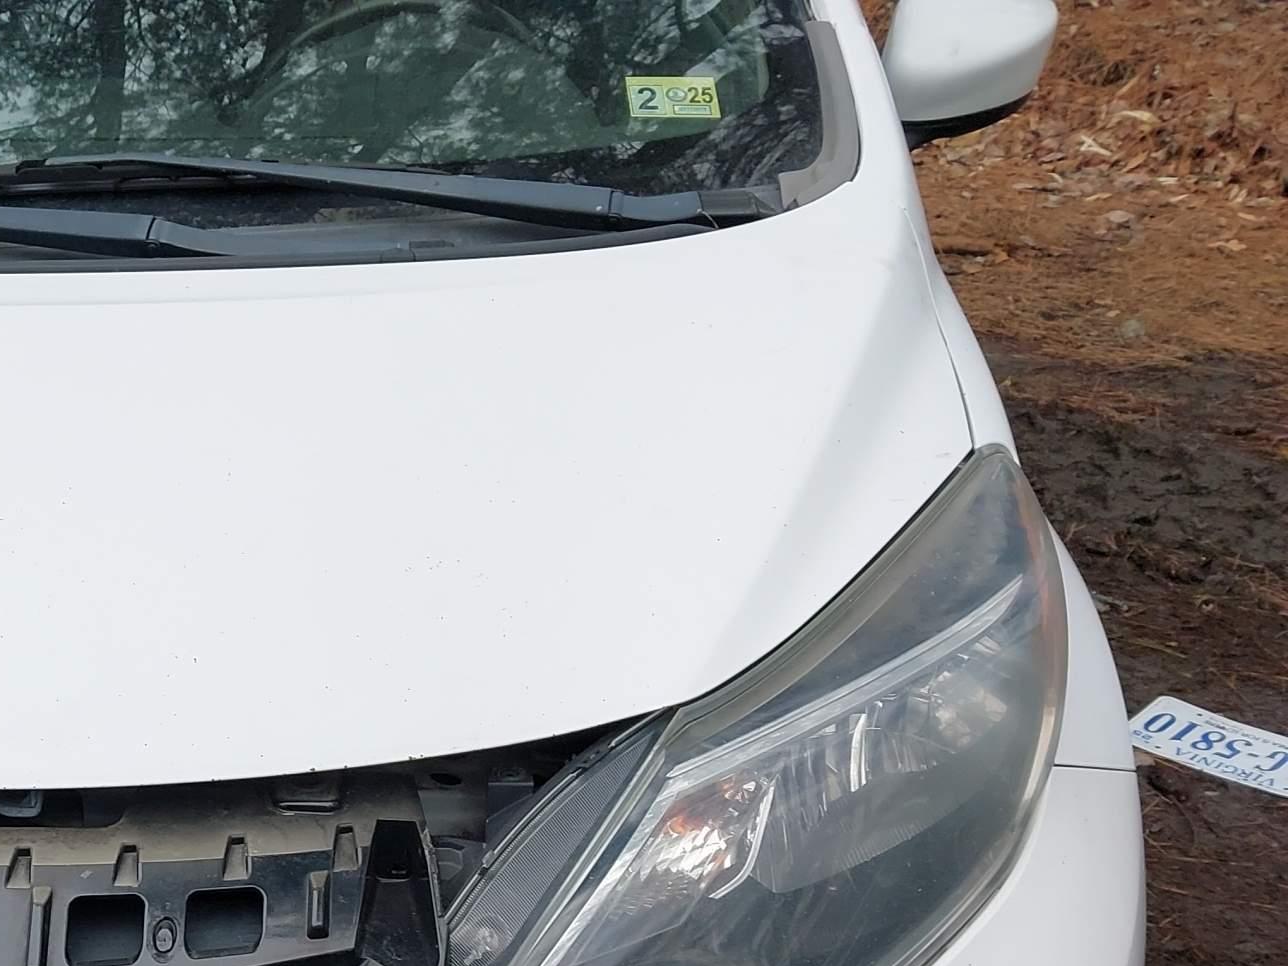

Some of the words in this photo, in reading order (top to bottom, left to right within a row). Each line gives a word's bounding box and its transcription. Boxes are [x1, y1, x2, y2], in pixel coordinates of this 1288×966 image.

[637, 87, 659, 110] 2
[687, 86, 714, 104] 25
[1176, 747, 1275, 787] VIRGINIA
